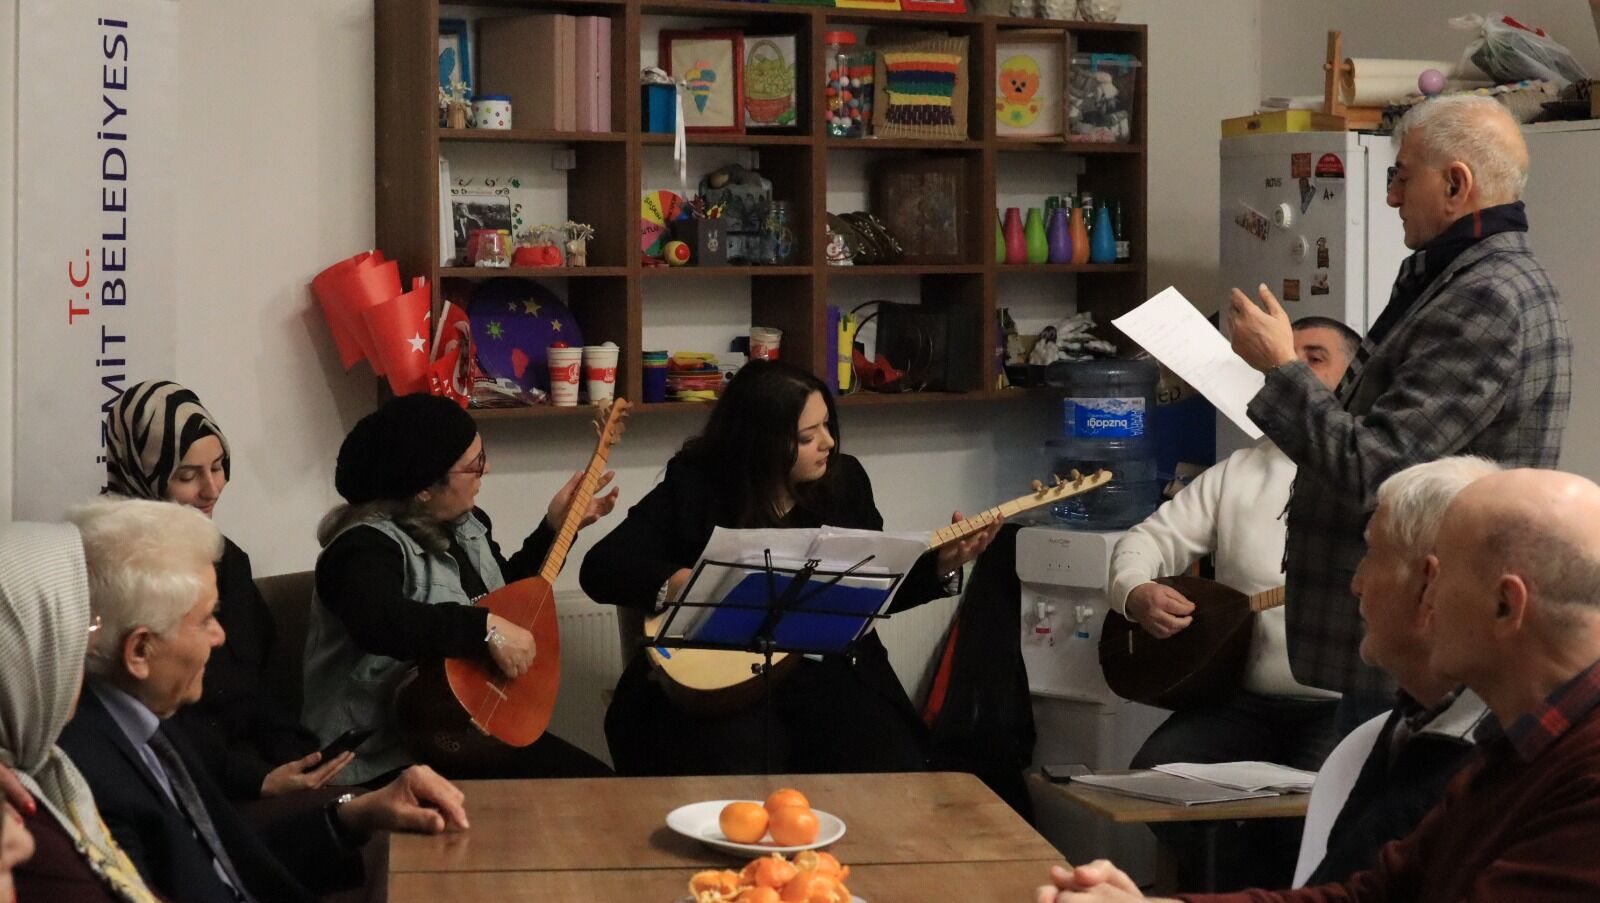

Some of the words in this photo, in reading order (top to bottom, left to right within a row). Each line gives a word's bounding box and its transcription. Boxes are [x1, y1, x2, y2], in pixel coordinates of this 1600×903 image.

[97, 17, 128, 306] BELEDİYESİ
[1323, 188, 1334, 200] A+
[68, 248, 90, 325] T.C.
[96, 325, 126, 464] MİT
[1087, 417, 1127, 429] buzdağı
